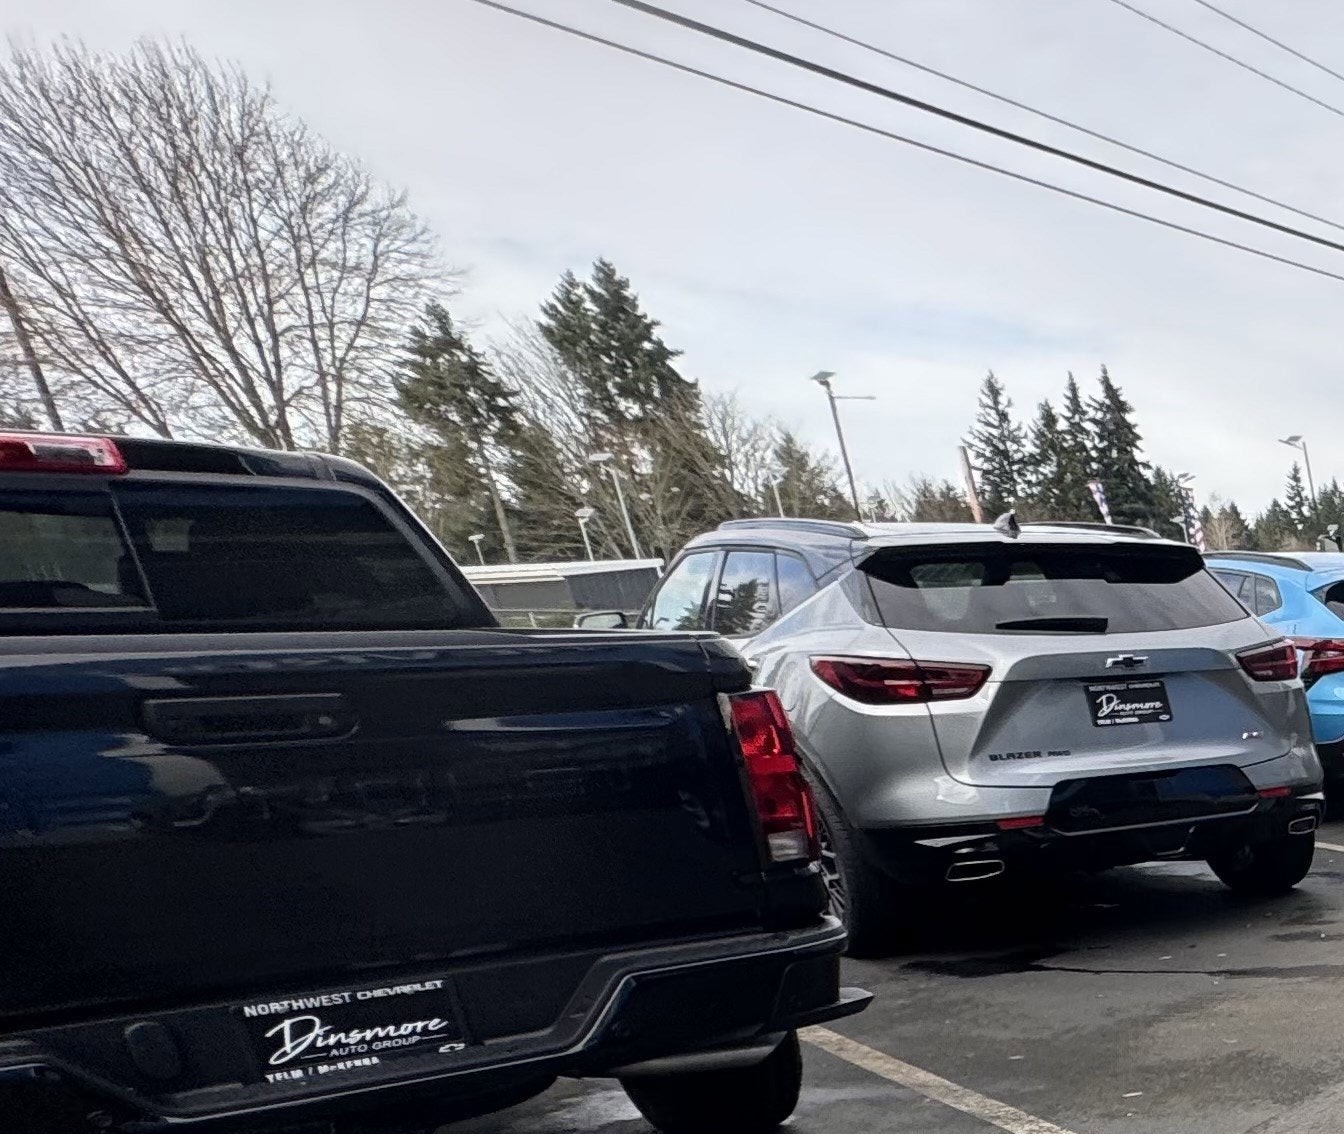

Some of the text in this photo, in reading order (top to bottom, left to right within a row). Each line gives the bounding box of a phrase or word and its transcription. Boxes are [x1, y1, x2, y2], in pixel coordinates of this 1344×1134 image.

[988, 751, 1042, 761] BLAZER
[243, 992, 353, 1017] NORTHWEST
[264, 1016, 449, 1065] Dinsmore
[329, 1035, 421, 1057] AUTO GROUP
